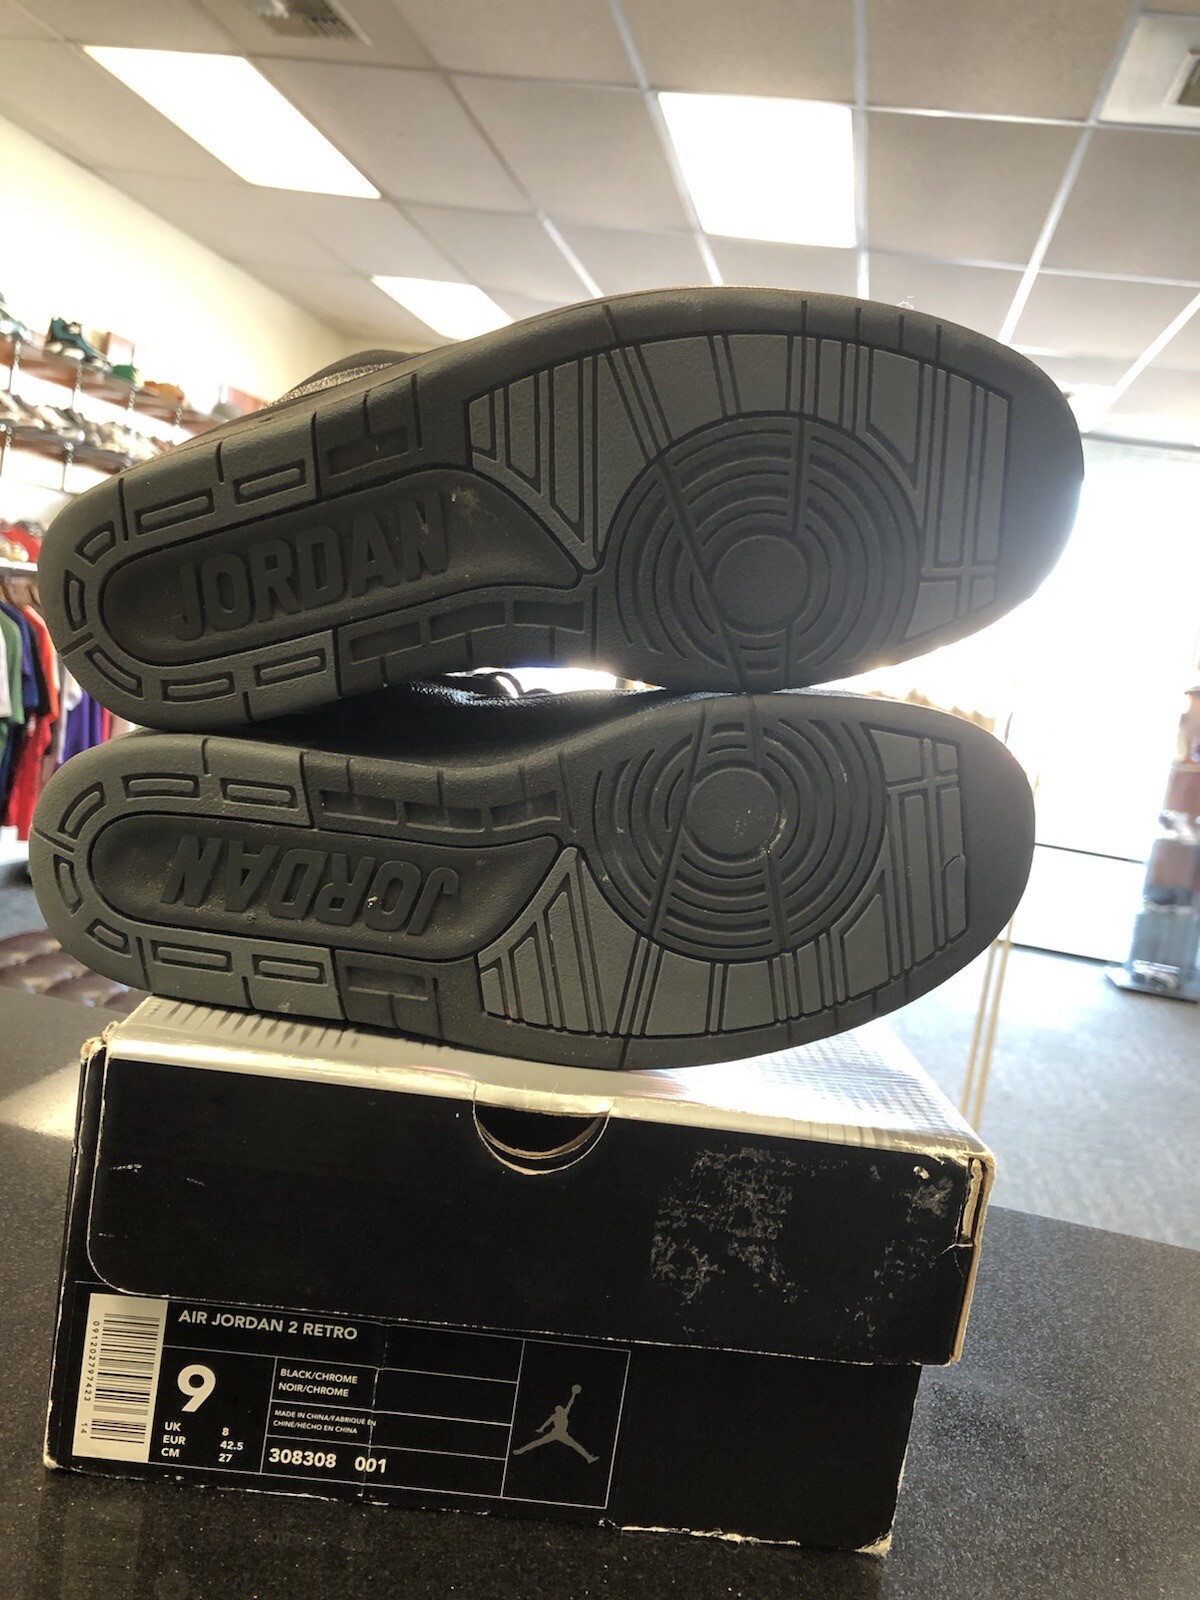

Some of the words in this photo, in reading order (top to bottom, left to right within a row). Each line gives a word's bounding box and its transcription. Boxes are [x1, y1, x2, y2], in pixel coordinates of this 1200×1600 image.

[169, 489, 448, 641] JORDAN
[160, 833, 460, 936] JORDAN
[178, 1309, 208, 1324] AIR
[211, 1313, 284, 1332] JORDAN
[287, 1321, 298, 1334] 2
[302, 1322, 358, 1341] RETRO
[83, 1321, 100, 1401] 091202797423
[280, 1368, 358, 1385] BLACK/CHROME
[177, 1363, 217, 1413] 9
[278, 1382, 349, 1398] NOIR/CHROME
[274, 1409, 296, 1418] MADE
[306, 1412, 366, 1425] CHINA/FABRIQUE
[80, 1423, 88, 1434] 14
[164, 1421, 182, 1433] UK
[222, 1427, 230, 1437] 8
[272, 1420, 323, 1431] CHINE/HECHO
[335, 1426, 358, 1434] CHINA
[162, 1434, 186, 1446] EUR
[220, 1439, 244, 1451] 42.5
[161, 1447, 180, 1458] CM
[218, 1452, 233, 1463] 27
[268, 1447, 337, 1468] 308308
[354, 1455, 387, 1473] 001
